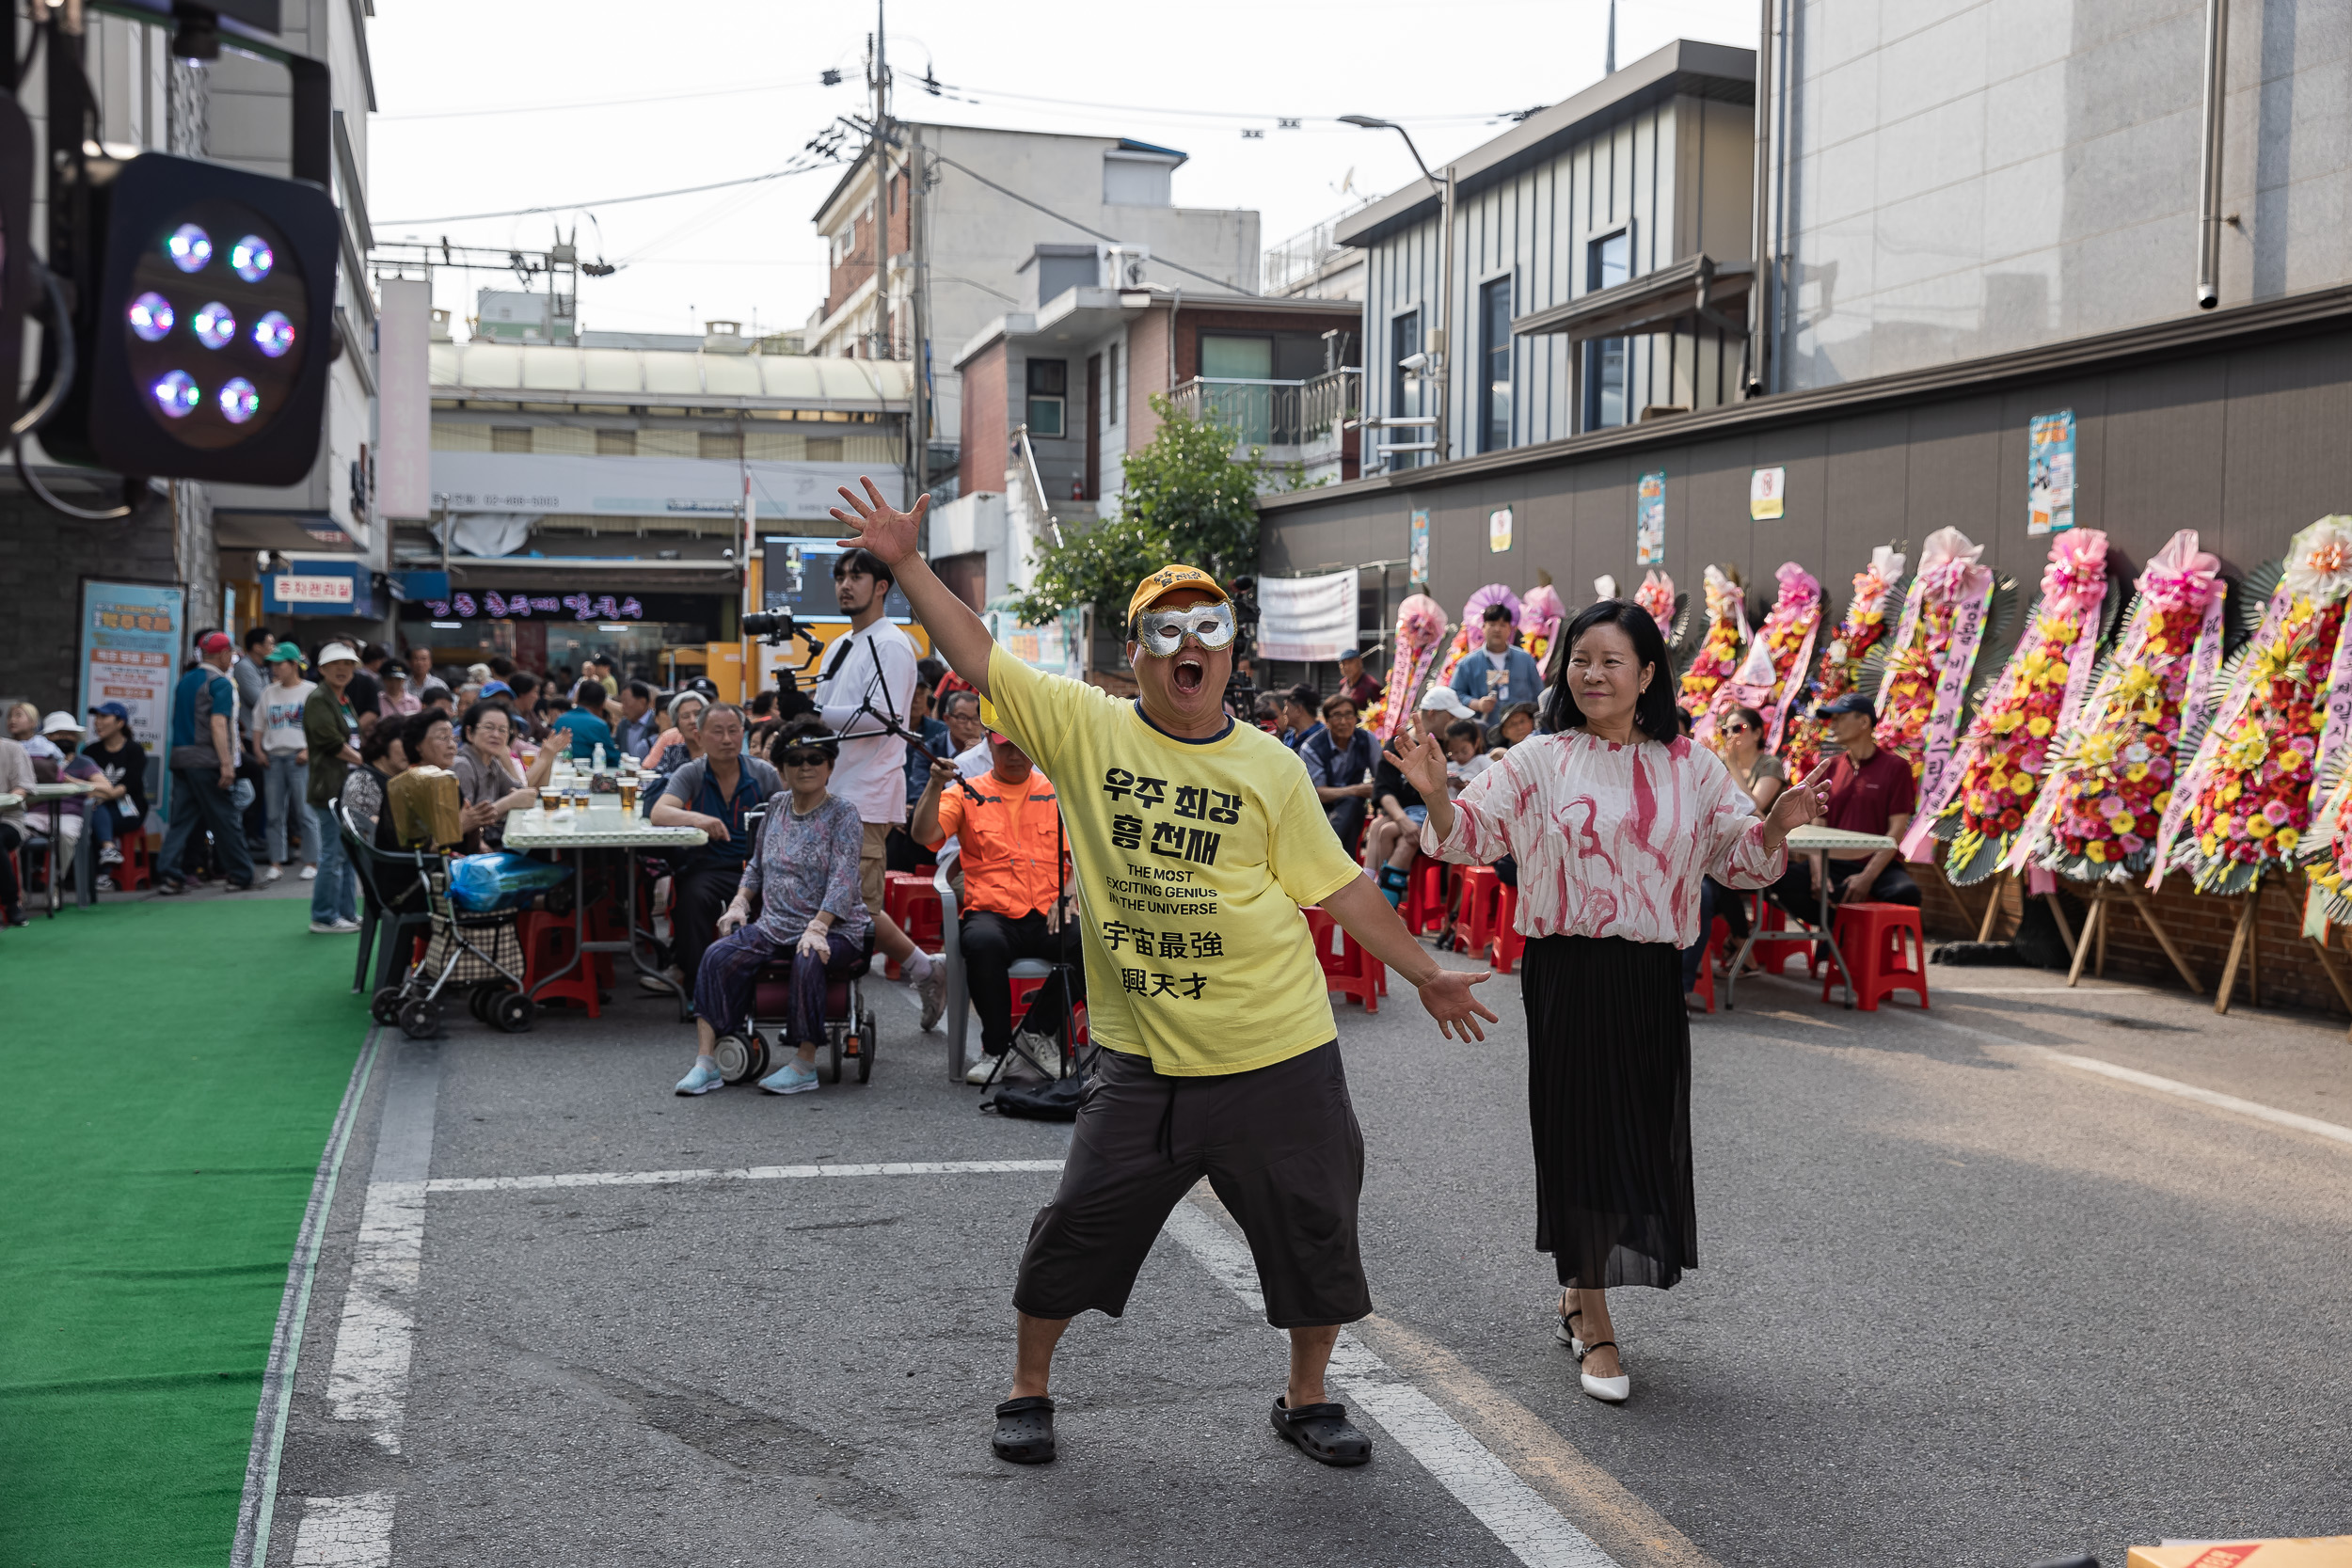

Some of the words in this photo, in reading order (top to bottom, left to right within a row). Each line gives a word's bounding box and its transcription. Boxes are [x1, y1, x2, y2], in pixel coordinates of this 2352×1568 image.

[1103, 768, 1168, 810] 우주
[1173, 784, 1244, 826] 최강
[1111, 814, 1143, 850] 흥
[1150, 821, 1221, 866] 천재
[1105, 876, 1162, 897] EXCITING
[1165, 886, 1218, 898] GENIUS
[1126, 863, 1152, 879] THE
[1153, 868, 1194, 883] MOST
[1108, 892, 1120, 906] IN
[1120, 896, 1145, 911] THE
[1147, 900, 1217, 915] UNIVERSE
[1103, 920, 1225, 959] 宇宙最強
[1120, 968, 1208, 1000] 興天才
